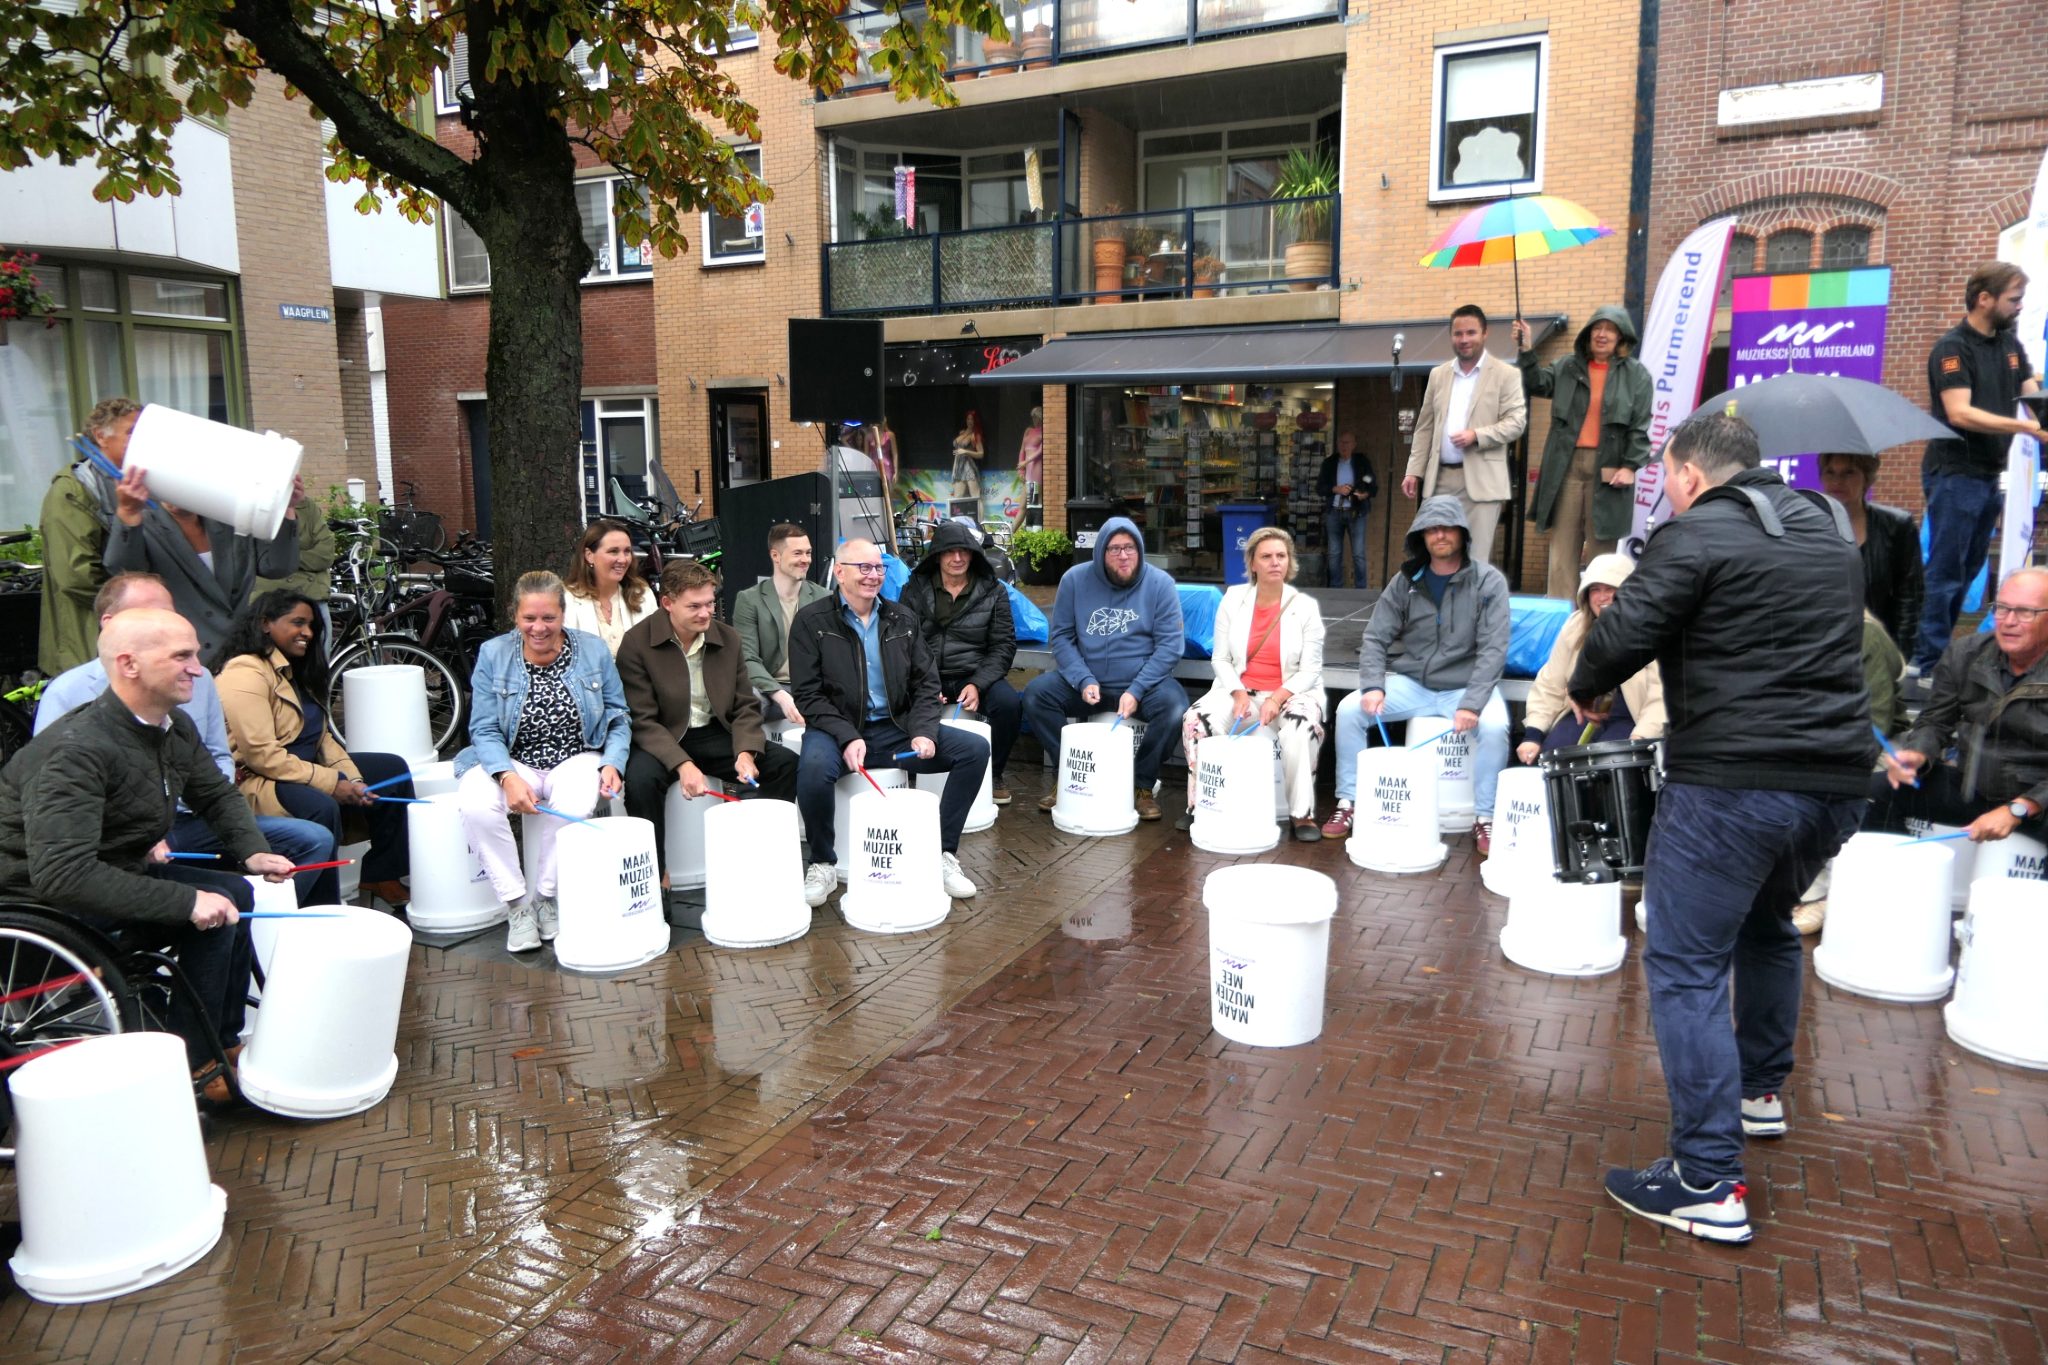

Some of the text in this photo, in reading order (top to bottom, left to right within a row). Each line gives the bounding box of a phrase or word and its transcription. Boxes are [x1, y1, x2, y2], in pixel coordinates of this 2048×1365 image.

[282, 305, 329, 320] WAAGPLEIN
[1656, 252, 1702, 393] Purmerend
[1736, 344, 1875, 361] MUZIEKSCHOOL WATERLAND
[770, 732, 783, 742] MA
[1440, 733, 1467, 745] MAAK
[1070, 747, 1094, 761] MAAK
[1436, 746, 1470, 756] MUZIEK
[1066, 757, 1096, 773] MUZIEK
[1201, 760, 1223, 776] MAAK
[1444, 757, 1463, 768] MEE
[1071, 770, 1088, 783] MEE
[1199, 771, 1226, 788] MUZIEK
[1379, 775, 1408, 789] MAAK
[1203, 784, 1217, 799] MEE
[1374, 787, 1412, 801] MUZIEK
[1382, 800, 1402, 813] MEE
[1511, 799, 1541, 815] MAAK
[867, 826, 898, 841] MAAK
[863, 839, 903, 855] MUZIEK
[623, 850, 651, 870] MAAK
[871, 855, 893, 869] MEE
[619, 863, 654, 886] MUZIEK
[631, 881, 650, 899] MEE
[1222, 969, 1243, 990] MEE
[1216, 981, 1255, 1009] MUZIEK
[1218, 999, 1249, 1025] MAAK
